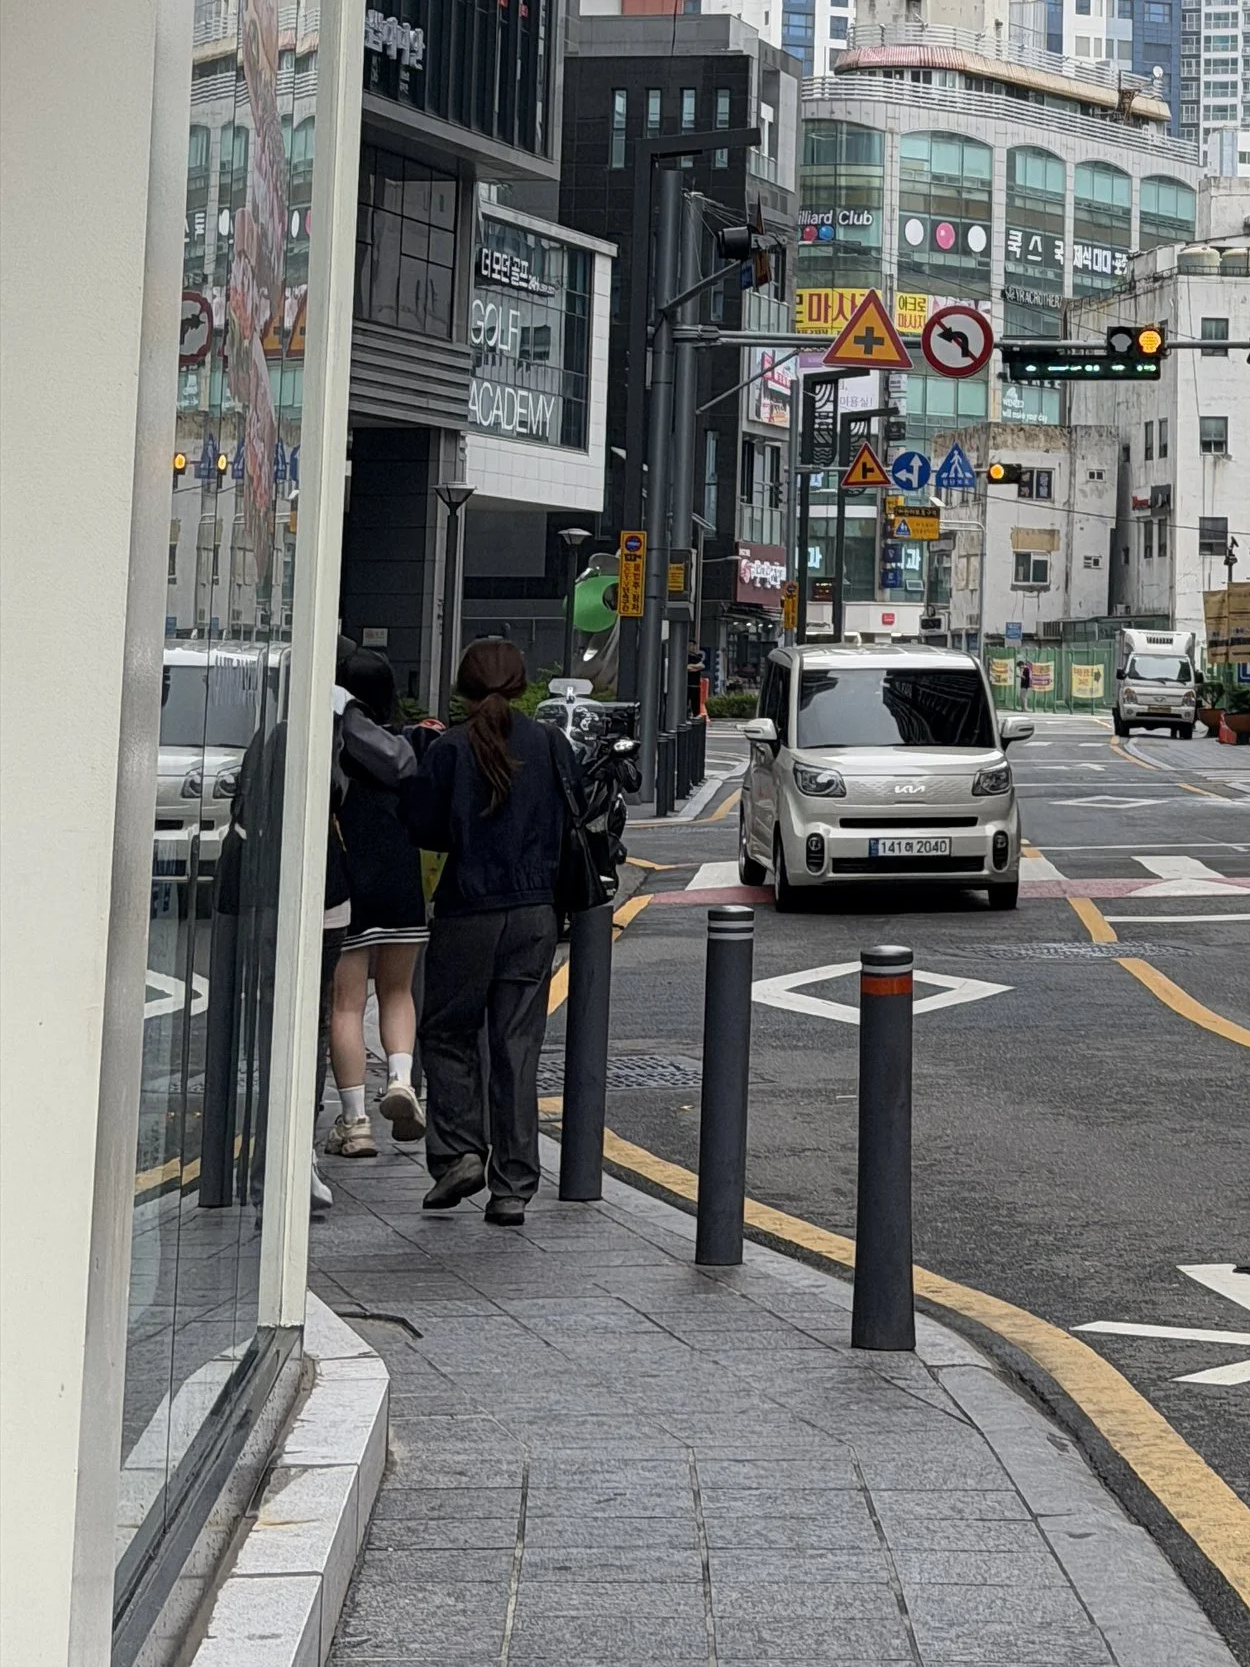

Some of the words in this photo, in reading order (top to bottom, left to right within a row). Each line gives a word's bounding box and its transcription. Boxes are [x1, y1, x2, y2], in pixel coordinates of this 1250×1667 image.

[838, 209, 874, 226] Club
[471, 299, 521, 352] GOLF
[468, 380, 556, 438] ACADEMY
[916, 839, 947, 854] 2040
